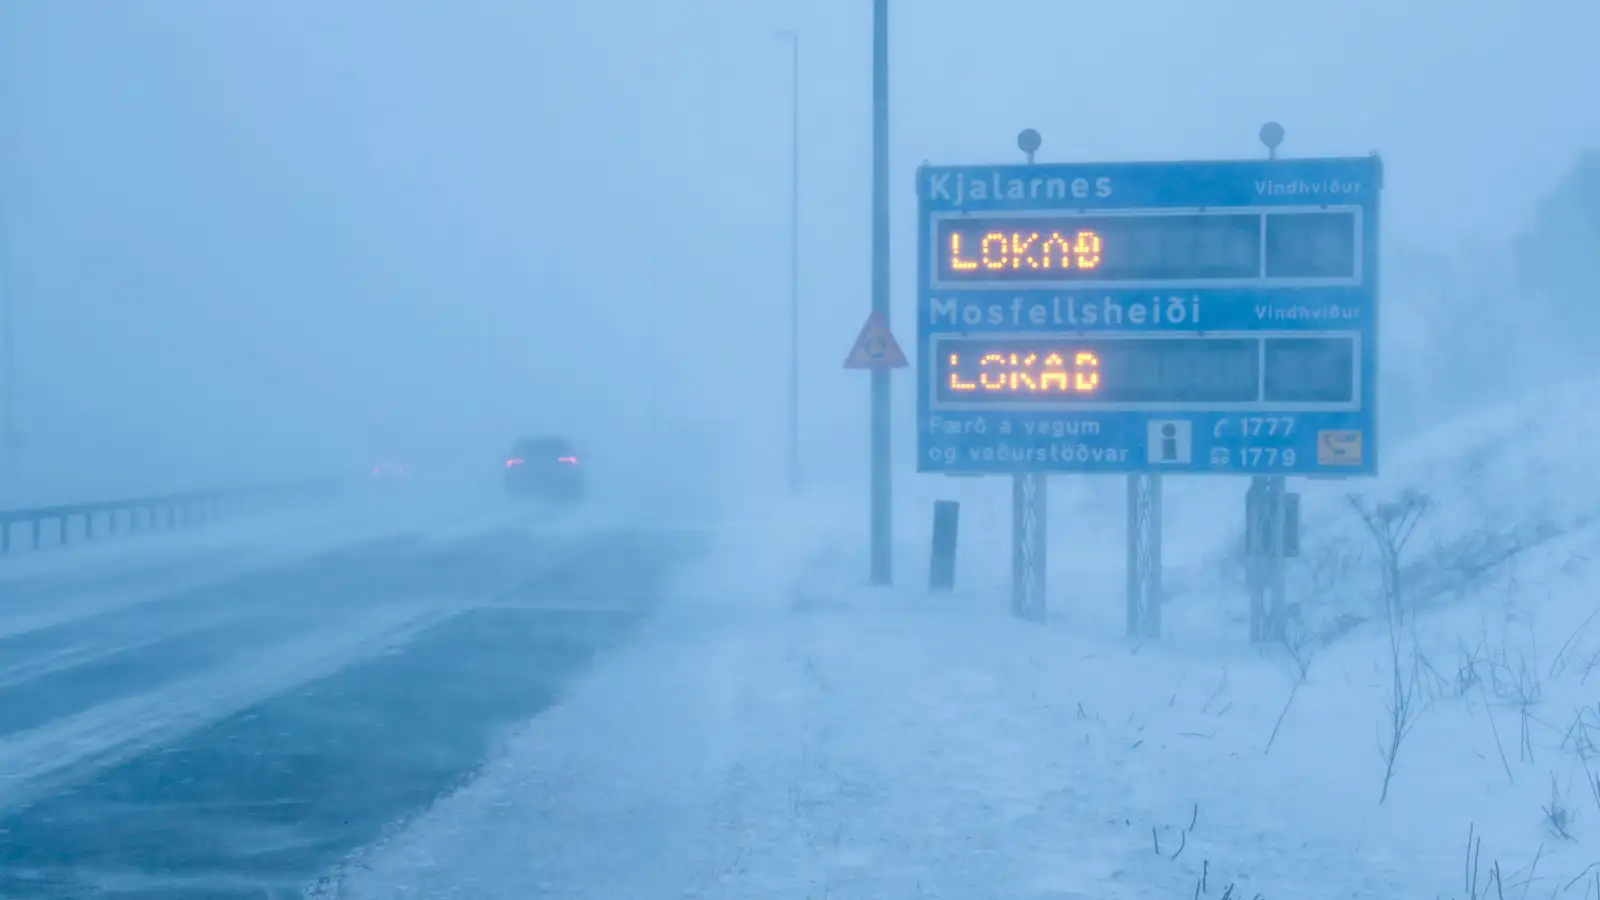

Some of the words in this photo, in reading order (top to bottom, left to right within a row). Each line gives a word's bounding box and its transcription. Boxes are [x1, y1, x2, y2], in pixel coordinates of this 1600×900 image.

[929, 172, 1113, 204] Kjalarnes
[929, 295, 1202, 325] Mosfellsheiði
[1022, 419, 1101, 438] vegum
[1240, 416, 1296, 437] 1777
[928, 446, 957, 464] og
[1239, 447, 1296, 467] 1779
